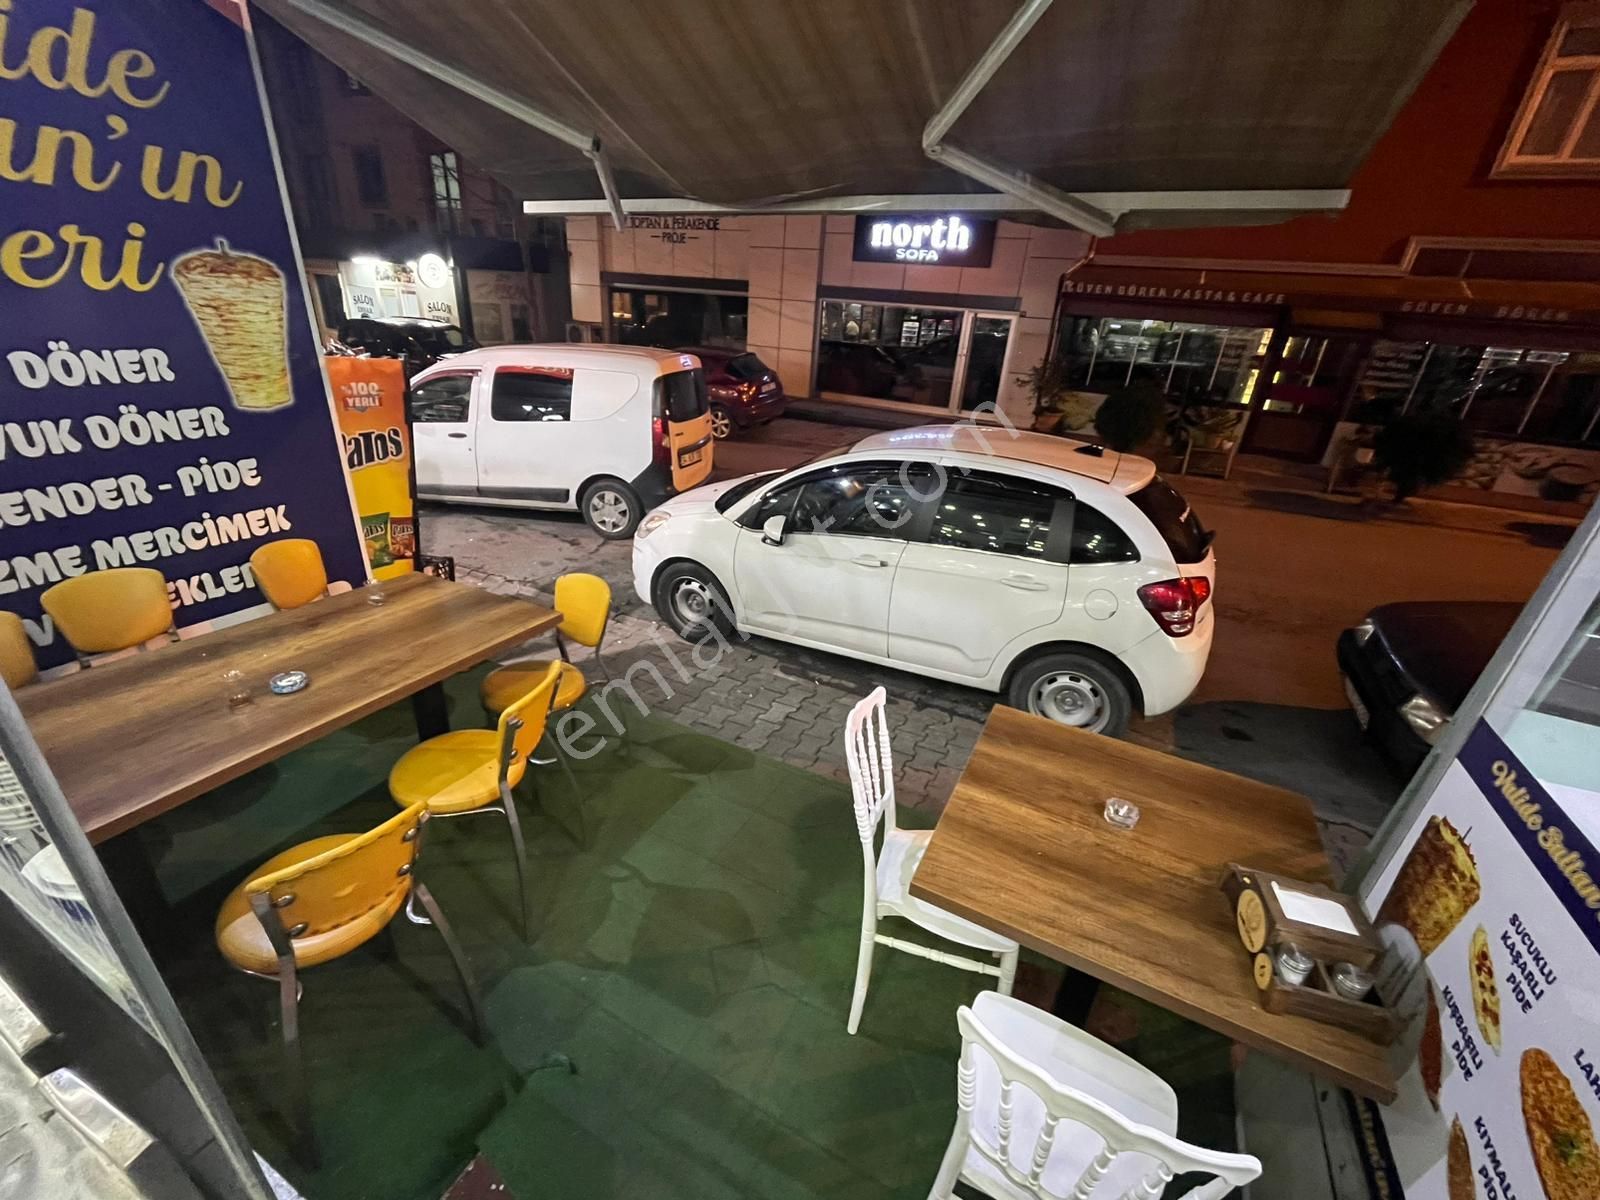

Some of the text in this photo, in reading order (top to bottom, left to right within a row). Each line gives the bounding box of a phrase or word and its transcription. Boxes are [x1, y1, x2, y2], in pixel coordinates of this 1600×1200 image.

[630, 216, 661, 229] TOPTAN
[673, 217, 720, 231] PERAKENDE
[662, 231, 687, 244] PROJE
[870, 215, 970, 250] north
[895, 248, 939, 261] SOFA
[353, 294, 374, 307] SALON
[427, 301, 453, 316] SALON
[1172, 288, 1223, 301] PASTA
[7, 341, 175, 389] DÖNER
[84, 404, 230, 449] DÖNER
[0, 473, 153, 530] ENDER
[176, 457, 262, 497] PİDE
[91, 504, 292, 572] MERCİMEK
[1500, 930, 1544, 1001] KAŞARLI
[1509, 913, 1557, 985] SUCUKLU
[1506, 972, 1533, 1014] PİDE
[1452, 1040, 1473, 1082] PİDE
[1573, 1047, 1600, 1101] LAH
